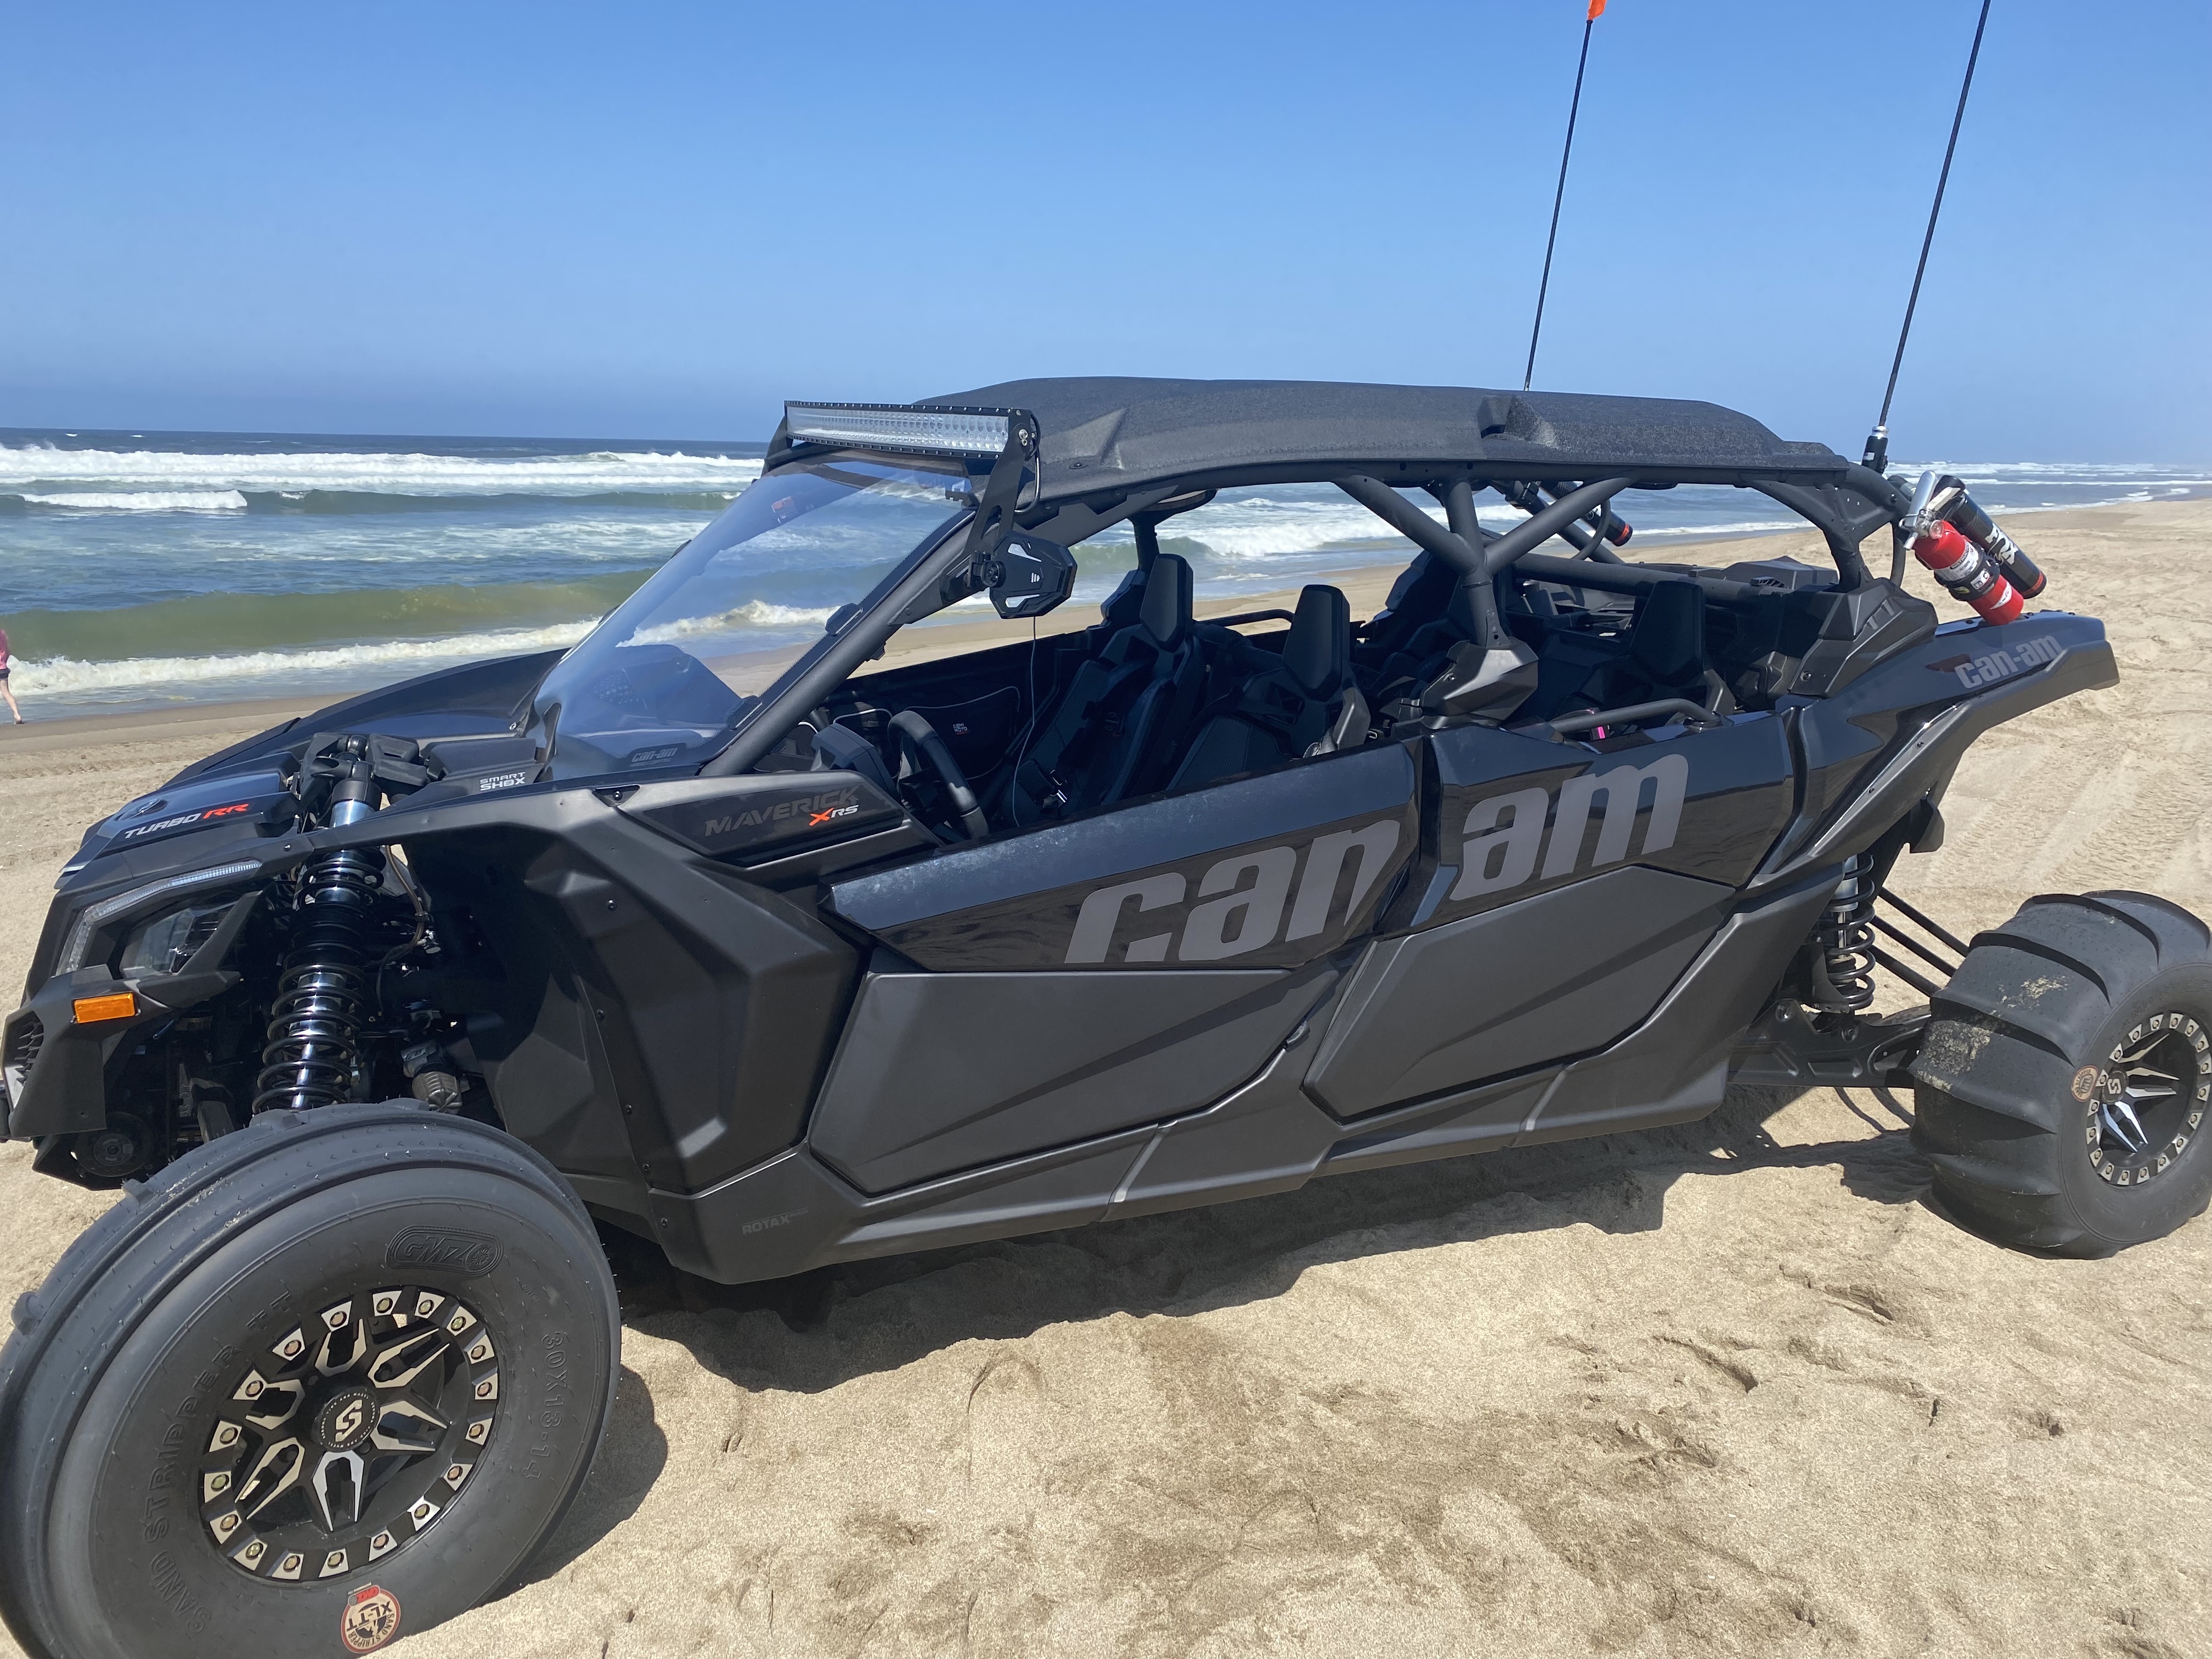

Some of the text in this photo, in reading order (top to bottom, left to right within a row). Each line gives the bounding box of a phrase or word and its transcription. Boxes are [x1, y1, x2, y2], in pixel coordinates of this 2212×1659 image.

[1954, 635, 2063, 689] can-am
[631, 747, 679, 763] can-am
[480, 771, 526, 785] SMART
[125, 803, 250, 839] TURBO RR
[705, 785, 860, 837] MAVERICK
[1449, 753, 1690, 901] am
[742, 1214, 791, 1235] ROTAX
[144, 1344, 243, 1543] STRIPPER
[150, 1550, 212, 1634] SAND
[346, 1600, 393, 1632] XL-TT
[348, 1613, 395, 1648] SAND STRIPPER
